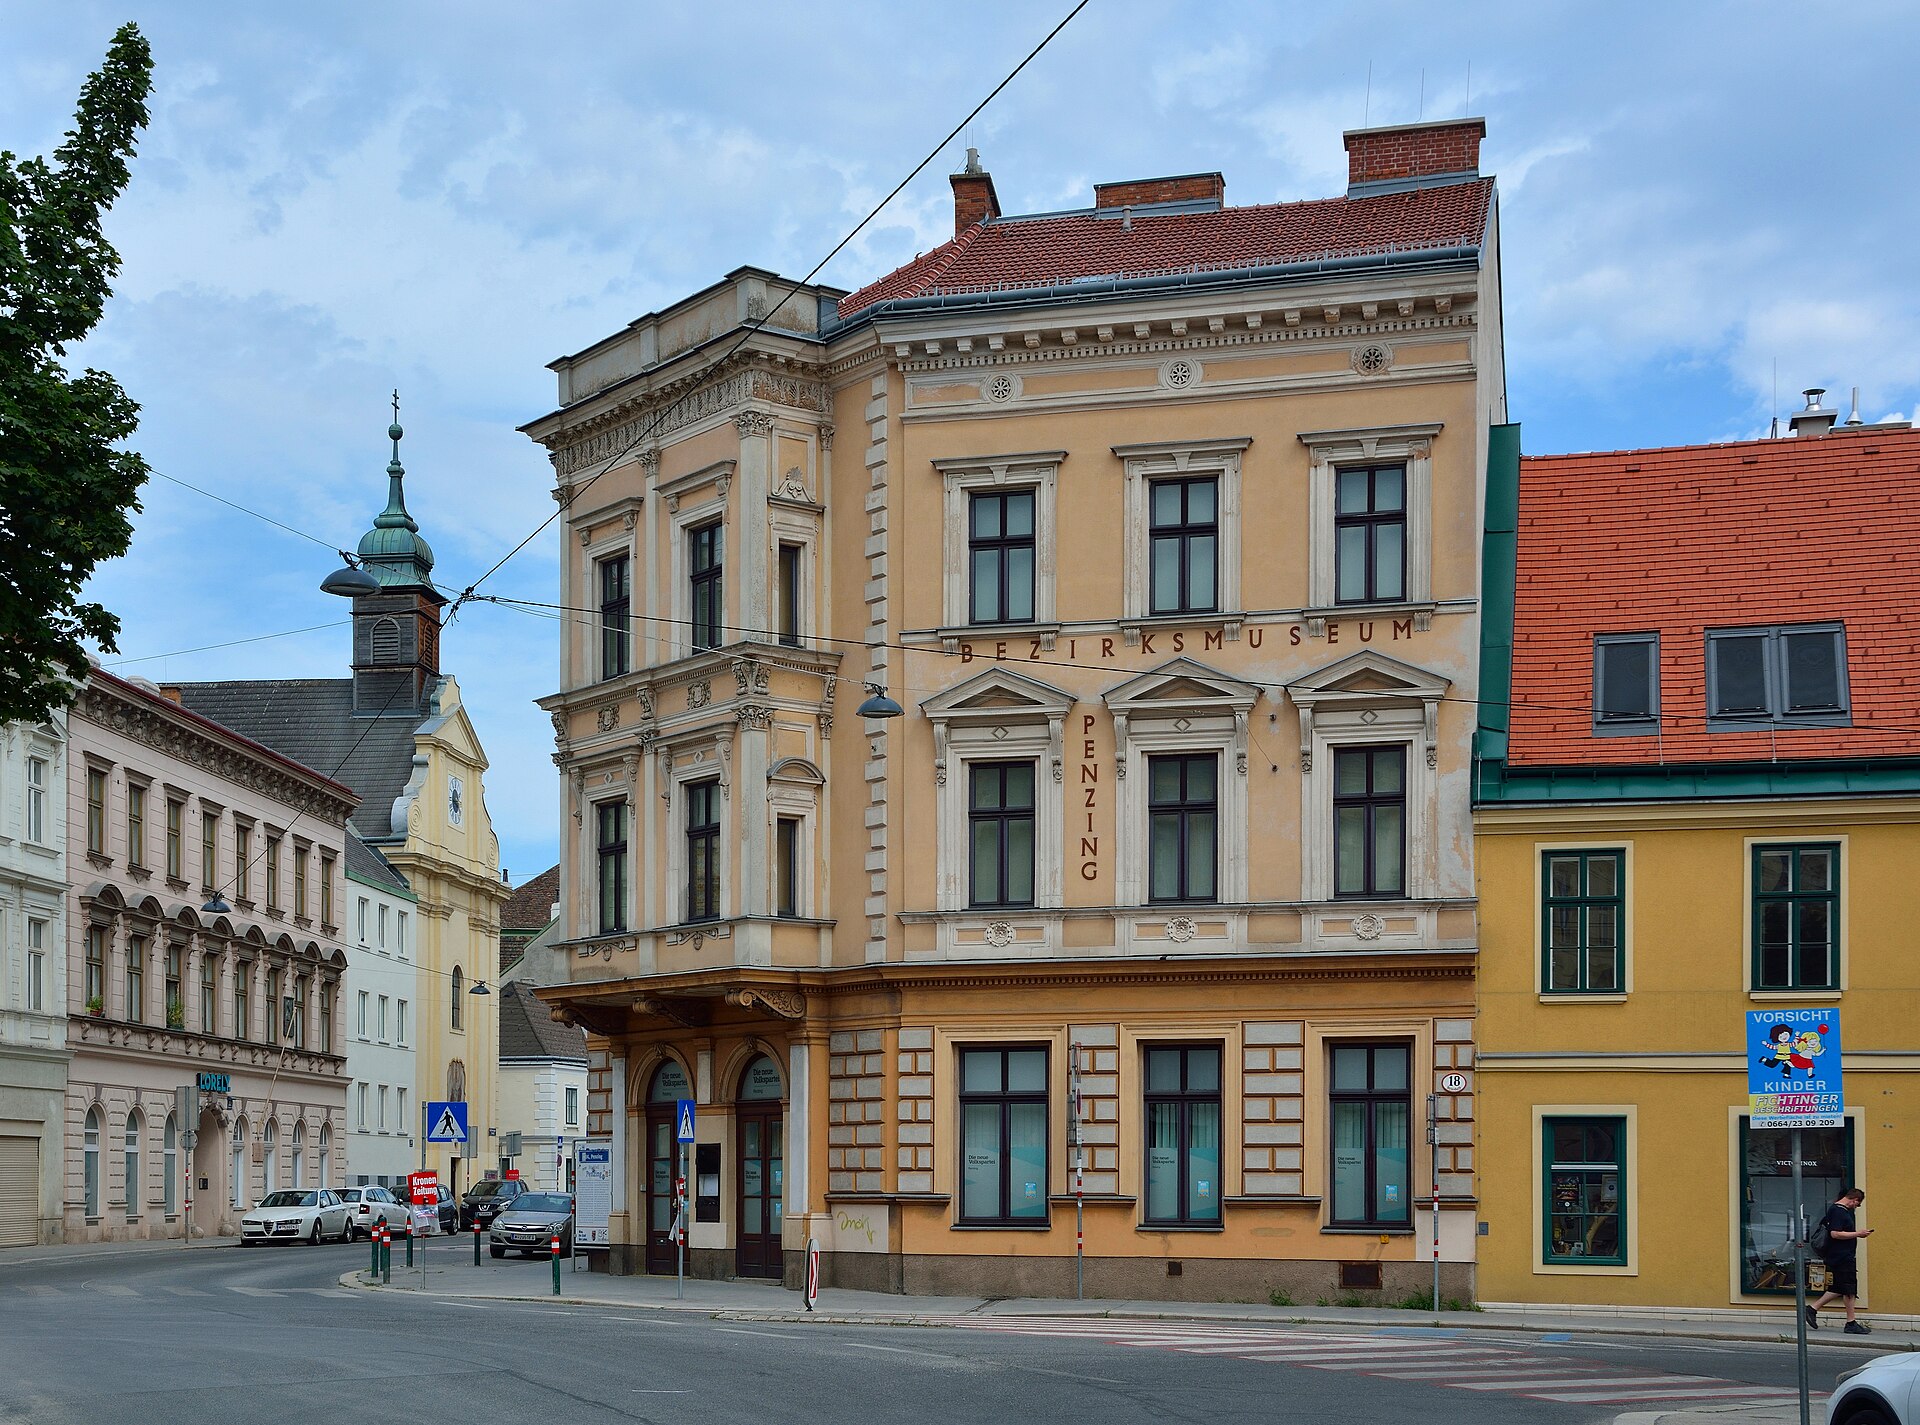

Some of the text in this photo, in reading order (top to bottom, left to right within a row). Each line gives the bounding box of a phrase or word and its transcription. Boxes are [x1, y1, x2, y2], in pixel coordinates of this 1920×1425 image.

[961, 619, 1411, 664] BEZIRKSMUSEUM
[1081, 715, 1099, 881] PENZING
[1753, 1010, 1832, 1023] VORSICHT
[1449, 1075, 1461, 1087] 18
[1764, 1080, 1827, 1092] KINDER
[412, 1176, 437, 1186] Kronen
[413, 1186, 437, 1196] Zeitung
